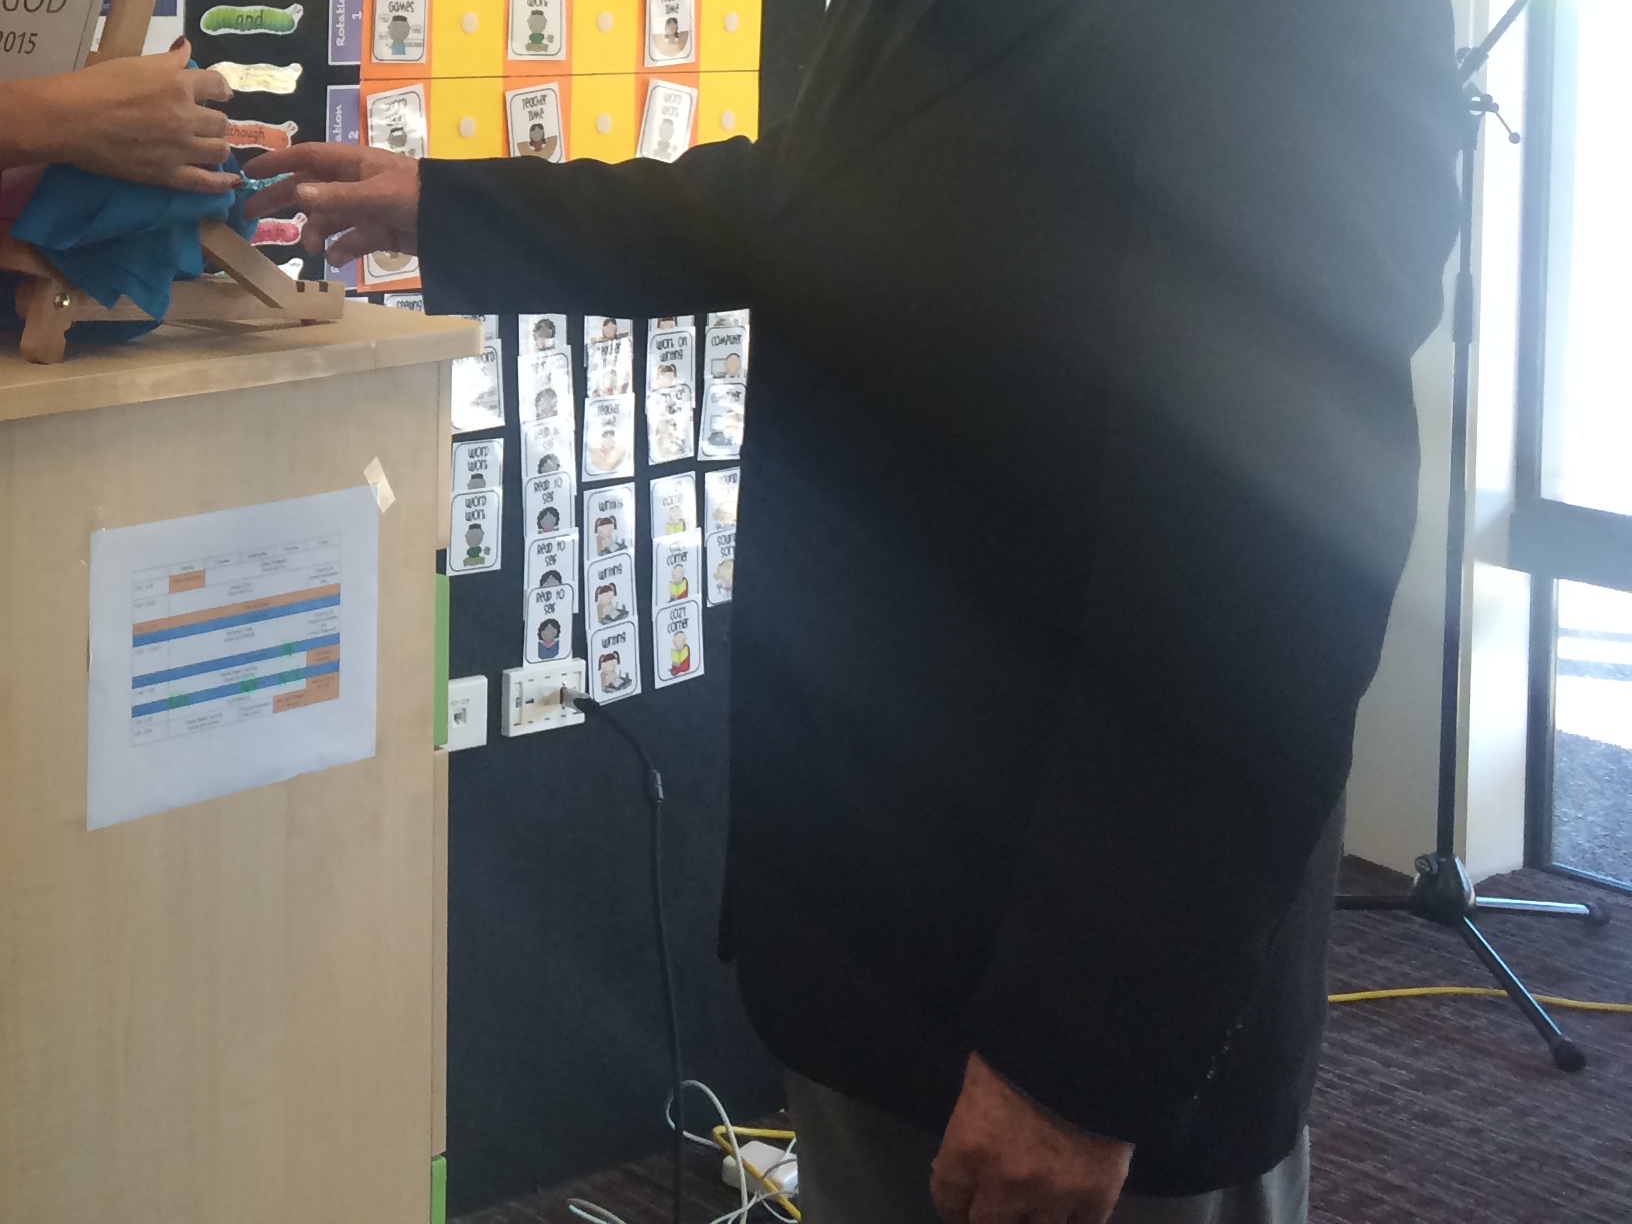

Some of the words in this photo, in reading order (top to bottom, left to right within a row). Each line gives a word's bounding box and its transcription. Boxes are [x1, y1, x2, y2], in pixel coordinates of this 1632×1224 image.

[236, 9, 263, 26] and
[351, 10, 362, 20] 1
[348, 130, 359, 140] 2
